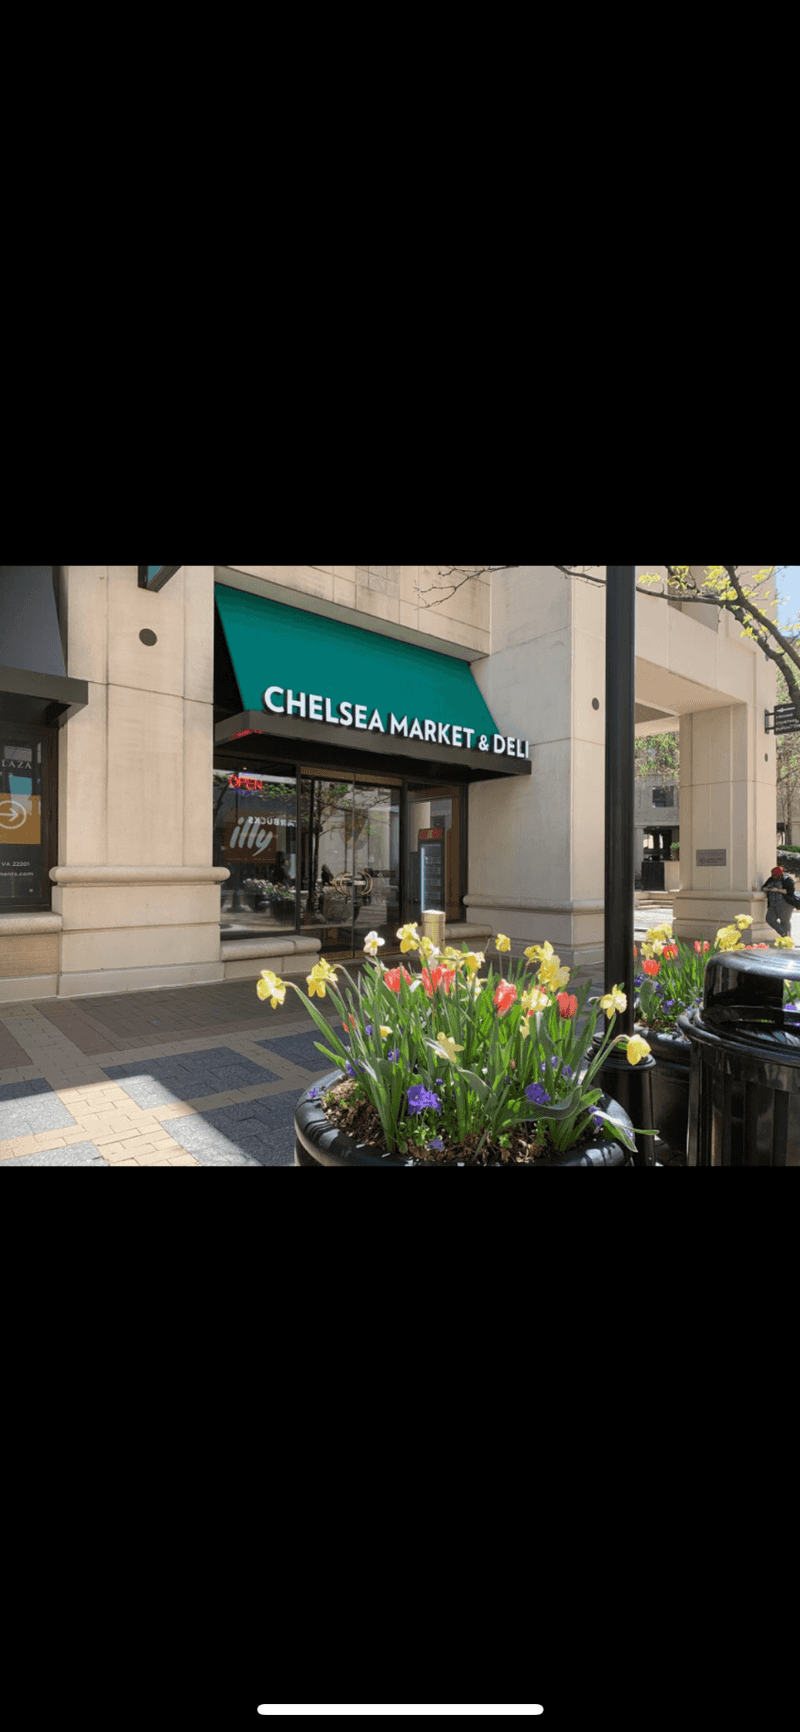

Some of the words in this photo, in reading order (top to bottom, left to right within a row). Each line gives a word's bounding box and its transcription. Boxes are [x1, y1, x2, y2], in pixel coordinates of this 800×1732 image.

[264, 685, 385, 732] CHELSEA
[390, 712, 475, 749] MARKET
[478, 734, 490, 752] &
[493, 733, 530, 759] DELI
[228, 774, 263, 792] OPEN
[229, 816, 273, 856] illy
